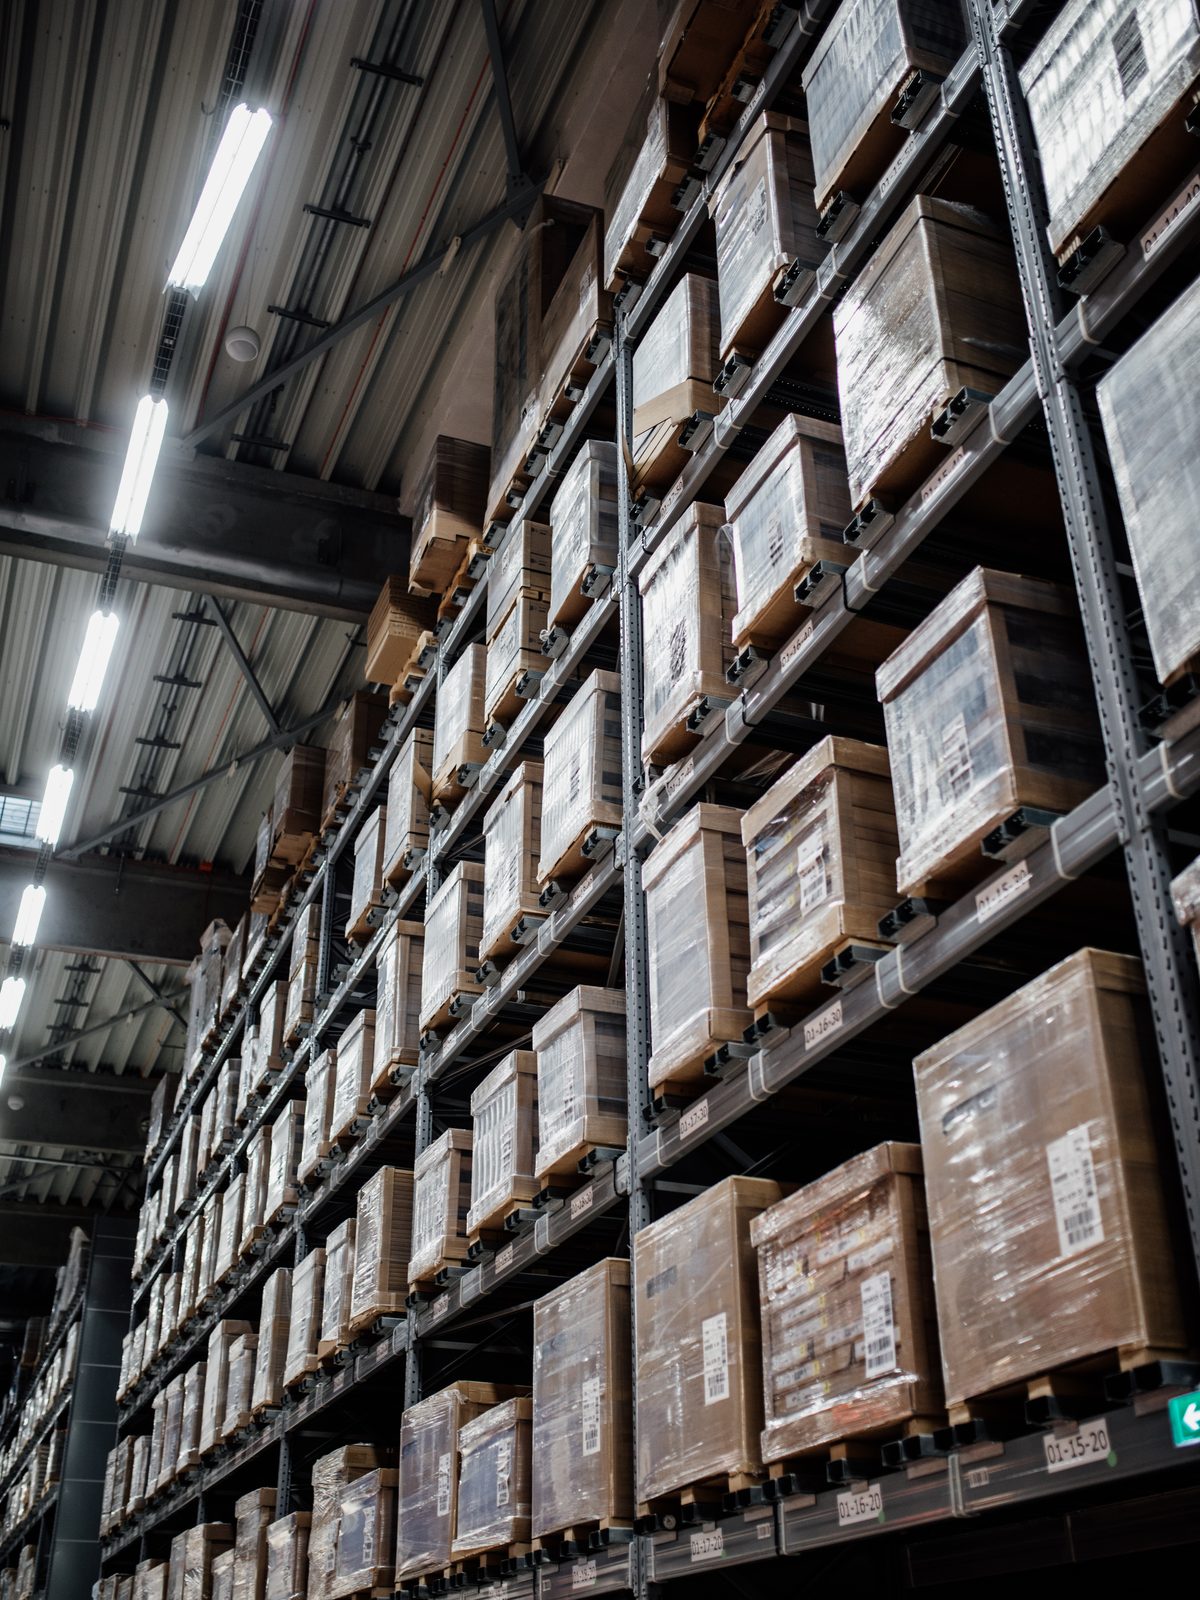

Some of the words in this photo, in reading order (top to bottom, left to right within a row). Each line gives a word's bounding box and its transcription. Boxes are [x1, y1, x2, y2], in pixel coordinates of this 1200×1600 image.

[805, 1008, 841, 1044] 01-16-30
[680, 1105, 708, 1136] 01-17-30
[1047, 1430, 1108, 1464] 01-15-20
[839, 1492, 882, 1519] 01-16-20
[691, 1536, 722, 1556] 01-17-20
